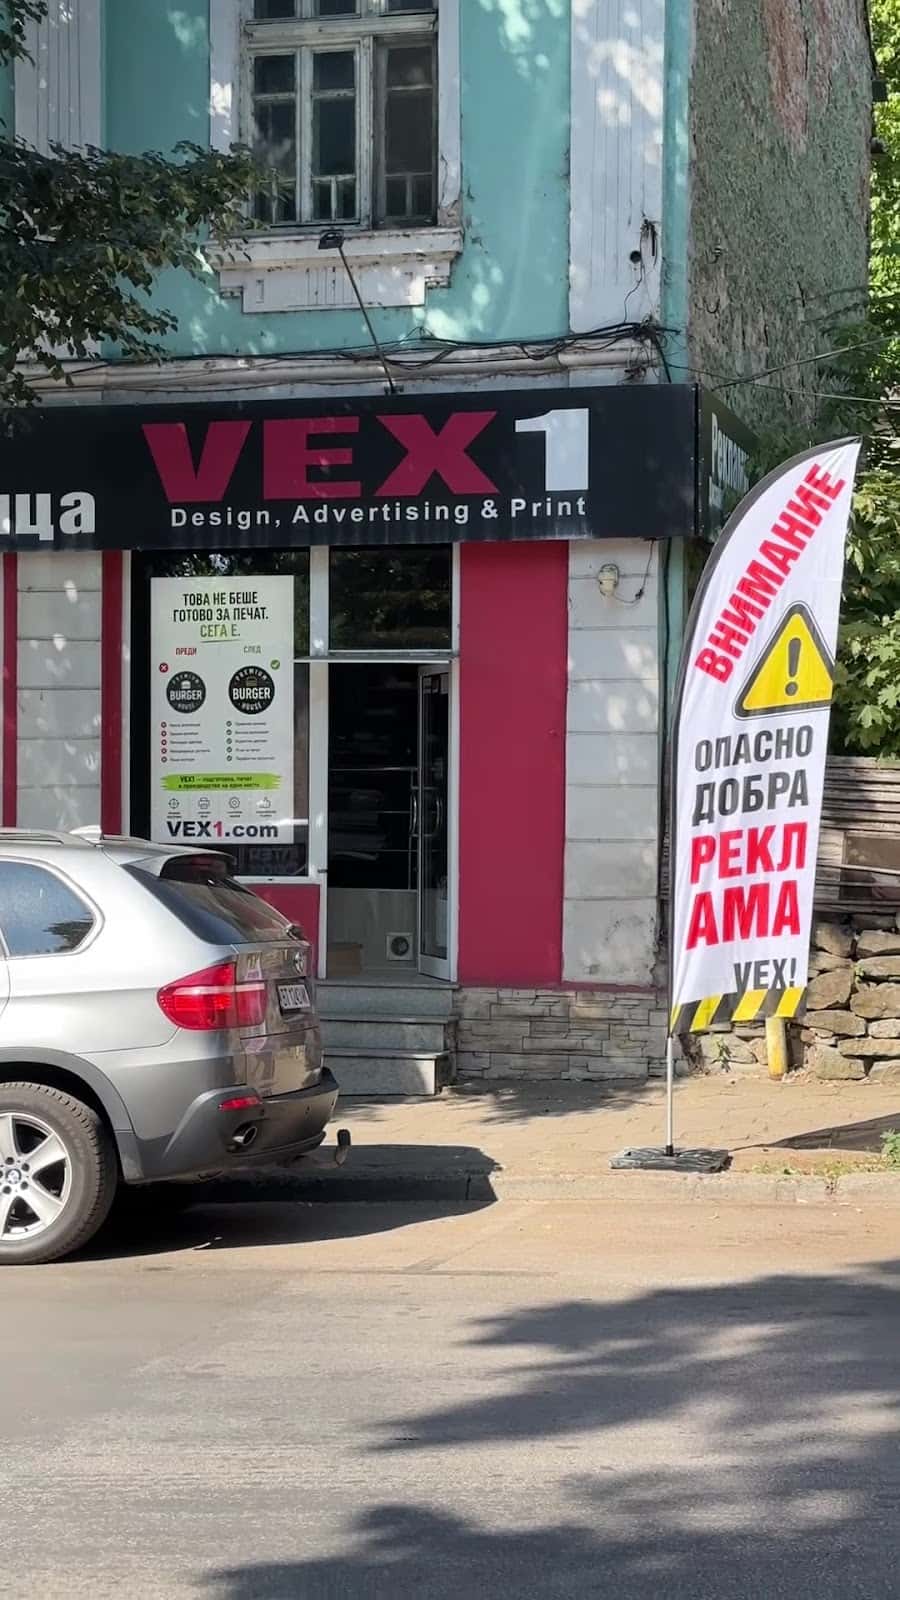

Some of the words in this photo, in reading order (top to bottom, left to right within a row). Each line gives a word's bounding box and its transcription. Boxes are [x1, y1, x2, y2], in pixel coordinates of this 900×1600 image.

[141, 408, 589, 503] VEX1
[0, 491, 96, 540] ца
[171, 507, 282, 530] Design,
[292, 501, 469, 525] Advertising
[481, 499, 498, 518] &
[511, 496, 587, 517] Print
[694, 463, 846, 683] ВНИМАНИЕ
[183, 593, 210, 606] ТОВА
[213, 592, 226, 605] НЕ
[229, 591, 258, 604] БЕШЕ
[173, 609, 213, 622] ГОТОВО
[216, 608, 230, 621] ЗА
[233, 606, 269, 620] ПЕЧАТ.
[200, 624, 227, 637] СЕГА
[231, 624, 240, 637] Е.
[175, 647, 197, 656] ПРЕДИ
[243, 645, 261, 654] СЛЕД
[169, 690, 202, 701] BURGER
[232, 687, 271, 700] BURGER
[694, 725, 814, 772] ОПАСНО
[692, 769, 809, 827] ДОБРА
[166, 821, 279, 838] VEX1.com
[690, 821, 808, 885] РЕКЛ
[686, 879, 801, 951] АМА
